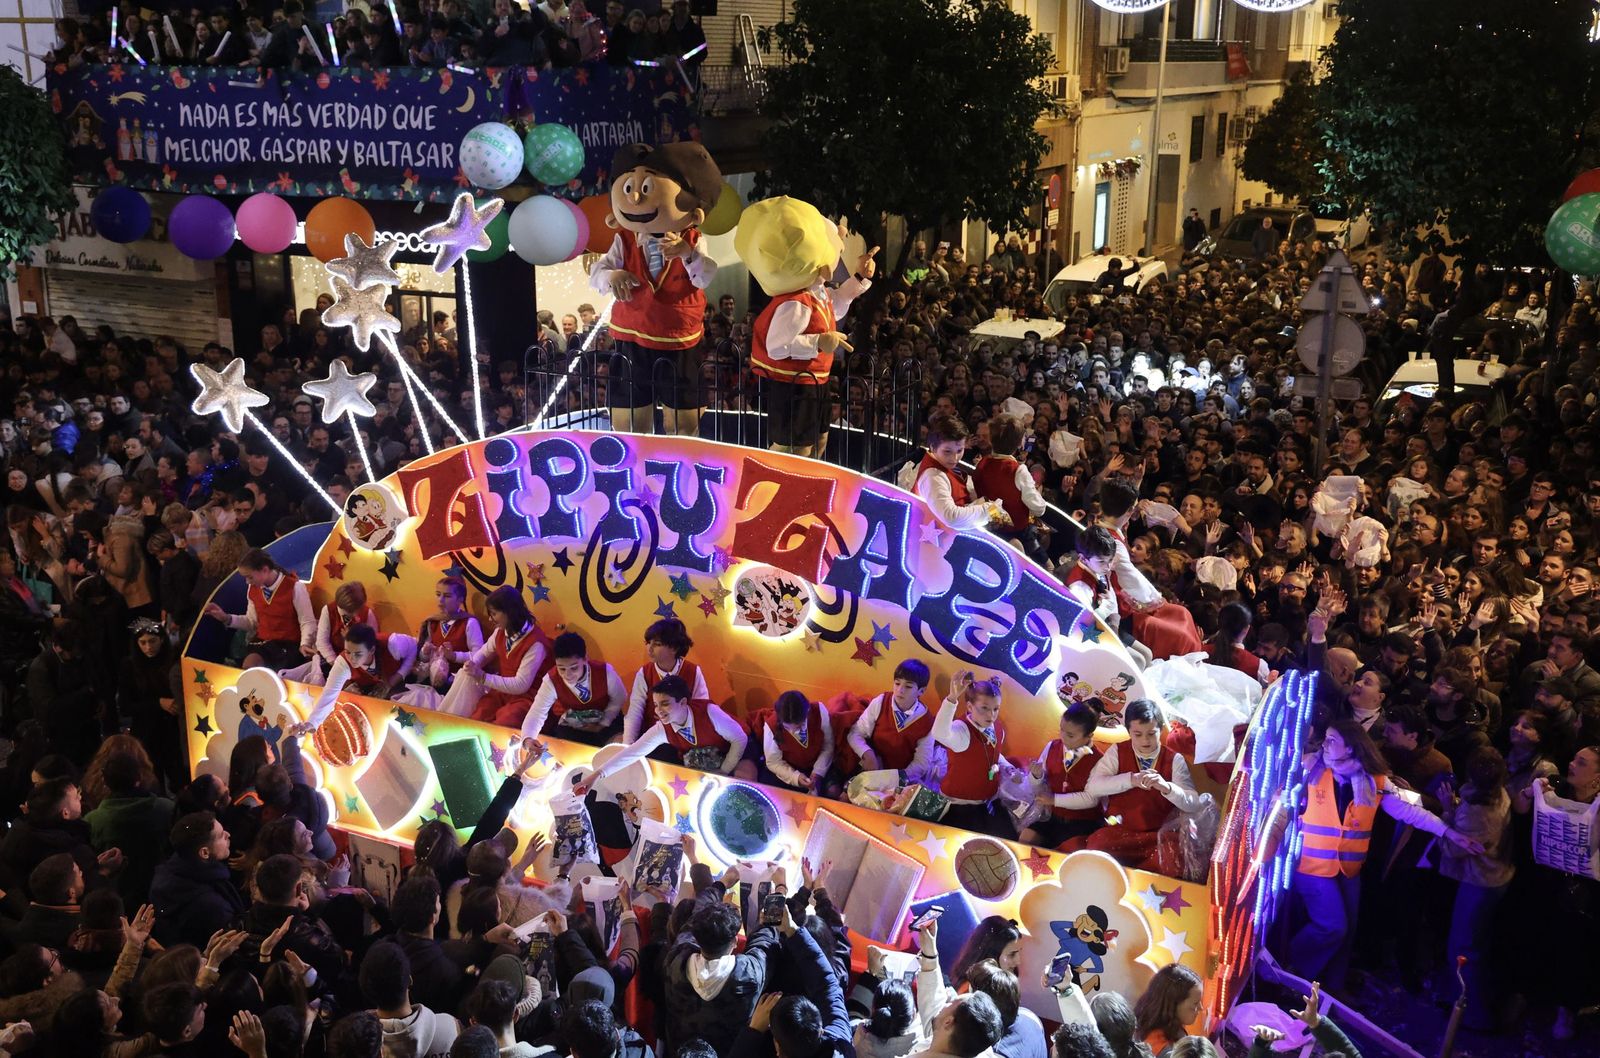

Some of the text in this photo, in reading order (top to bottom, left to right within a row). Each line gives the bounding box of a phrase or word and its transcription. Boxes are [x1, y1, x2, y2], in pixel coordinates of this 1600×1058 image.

[179, 101, 230, 129] NADA
[234, 101, 258, 128] ES
[307, 101, 387, 131] VERDAD
[392, 103, 438, 131] QUE
[582, 111, 644, 148] ARTABÁN
[164, 136, 454, 169] MELCHOR, GASPAR Y BALTASAR
